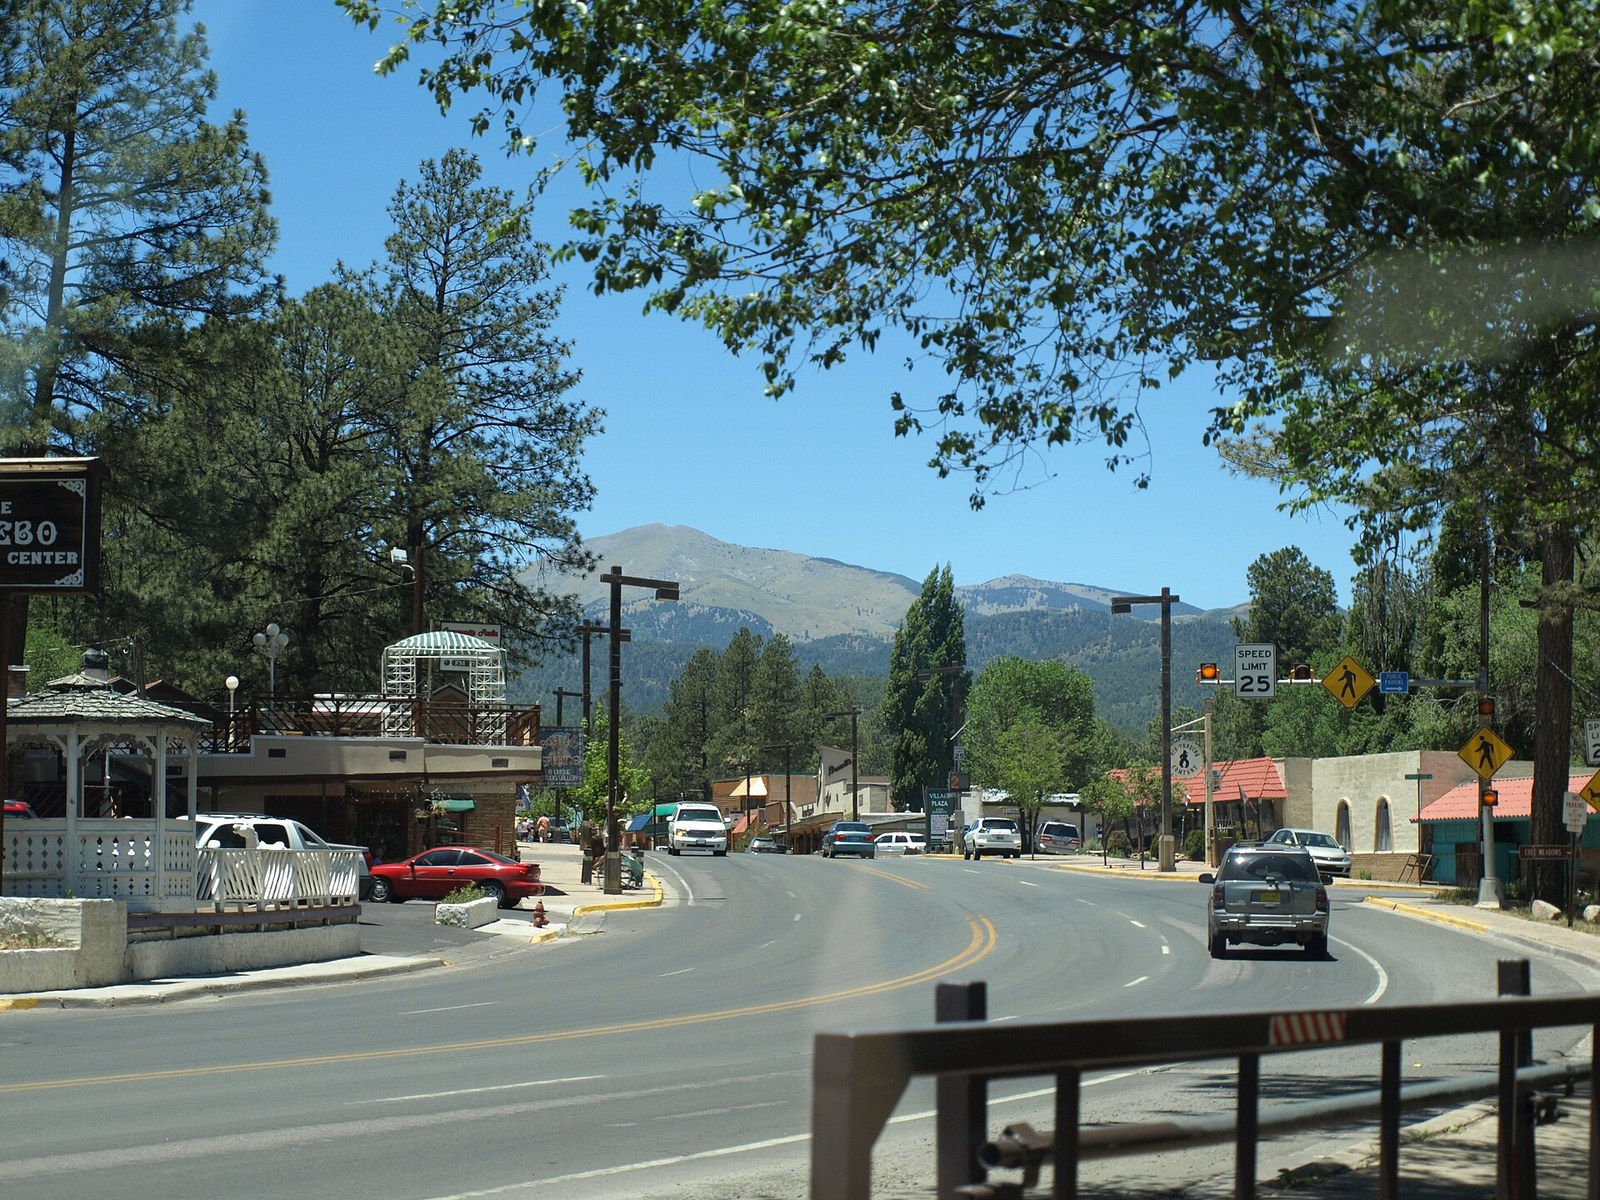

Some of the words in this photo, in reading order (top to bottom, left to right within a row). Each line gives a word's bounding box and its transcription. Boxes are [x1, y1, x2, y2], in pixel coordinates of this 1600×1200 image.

[7, 551, 79, 565] CENTER
[1238, 650, 1272, 658] SPEED
[1241, 662, 1268, 671] LIMIT
[1240, 675, 1271, 693] 25
[1171, 764, 1198, 775] COMPANY
[1566, 801, 1585, 809] PARKING
